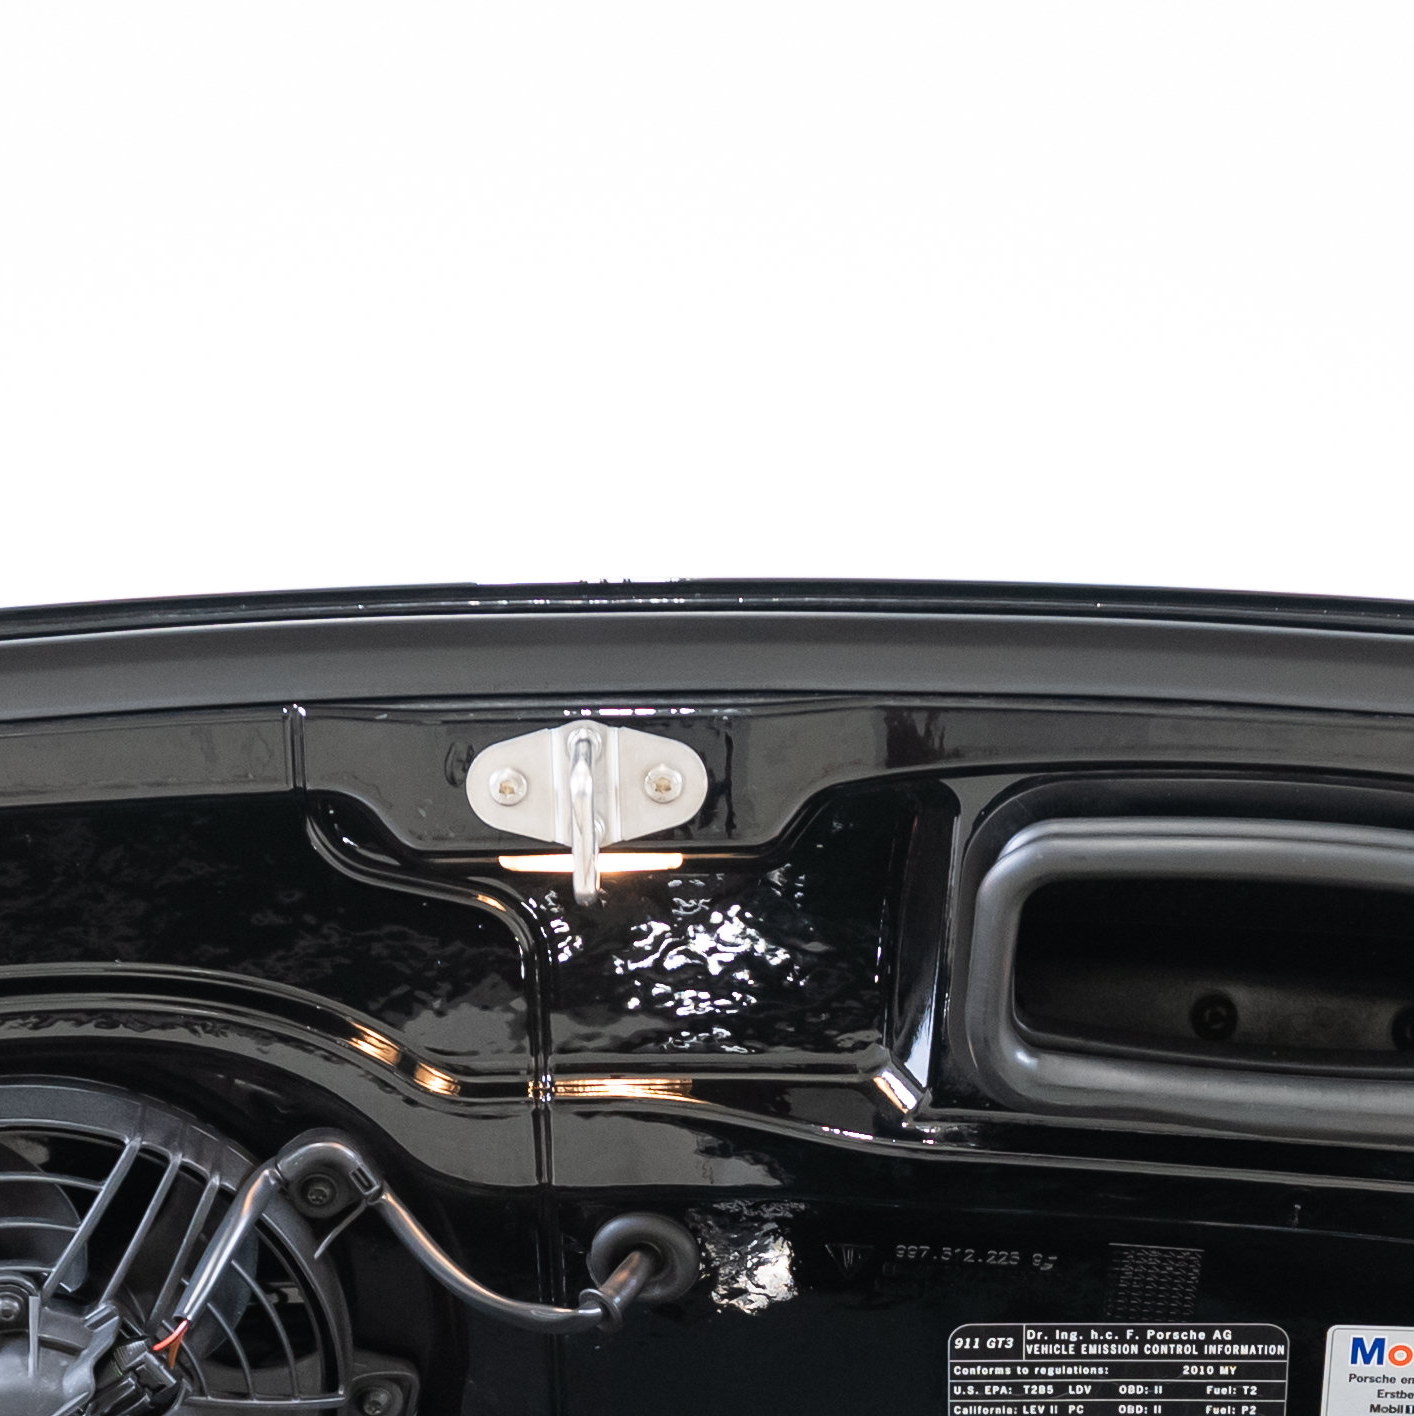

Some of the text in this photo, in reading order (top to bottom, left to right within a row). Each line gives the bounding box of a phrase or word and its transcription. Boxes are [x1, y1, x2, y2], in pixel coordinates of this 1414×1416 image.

[1026, 1329, 1233, 1342] Dr. Ing. h.c. F. Porsche AG
[954, 1337, 1014, 1349] 911 GT3
[1026, 1344, 1285, 1356] VEHICLE EMISSION CONTROL INFORMATION
[953, 1365, 1109, 1377] Conforms to regulations:
[1182, 1365, 1237, 1376] 2010 MY
[1348, 1373, 1396, 1384] Porsche
[953, 1385, 1258, 1396] U.S. EPA: T2B5 LDV OBD: II Fuel: T2
[953, 1405, 1257, 1415] California: LEV II PC OBD: II Fuel: P2
